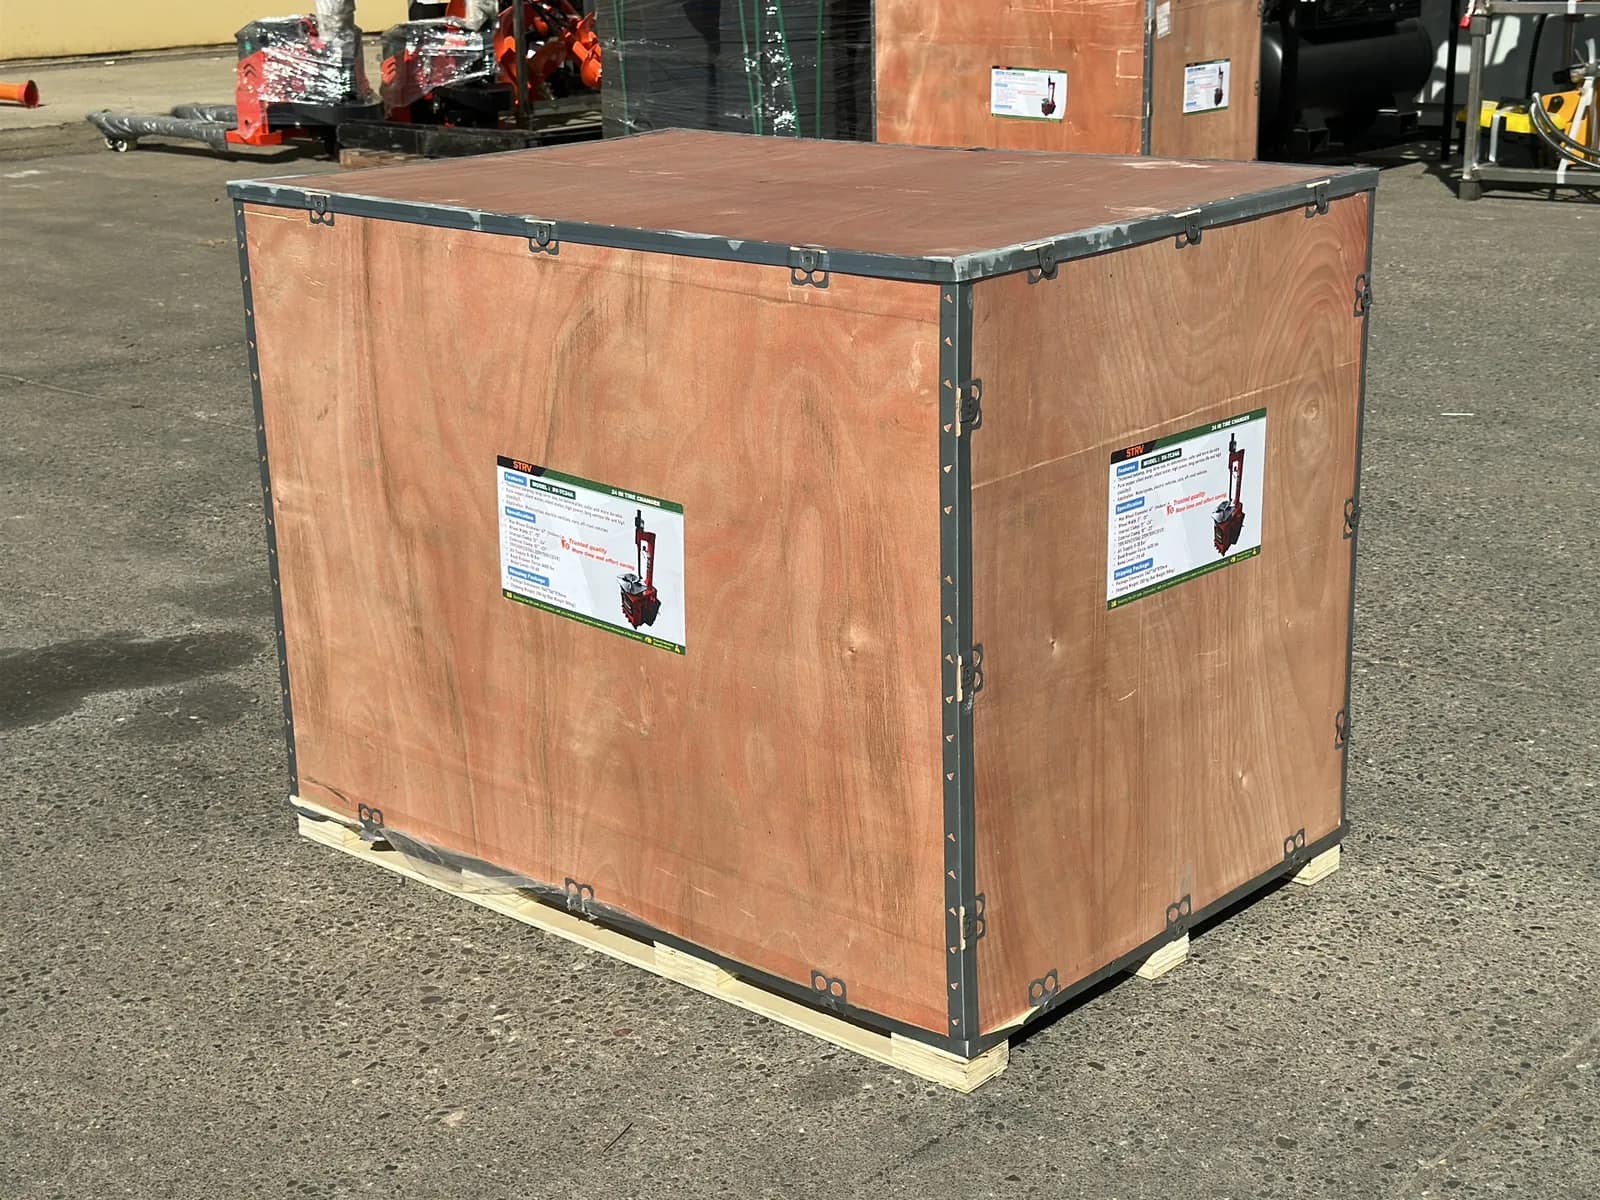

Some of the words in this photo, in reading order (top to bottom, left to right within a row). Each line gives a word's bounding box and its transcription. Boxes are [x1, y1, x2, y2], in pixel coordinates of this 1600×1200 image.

[1126, 445, 1144, 458] STRV
[513, 460, 532, 473] STRV
[570, 538, 589, 549] Trusted
[589, 544, 608, 555] quality
